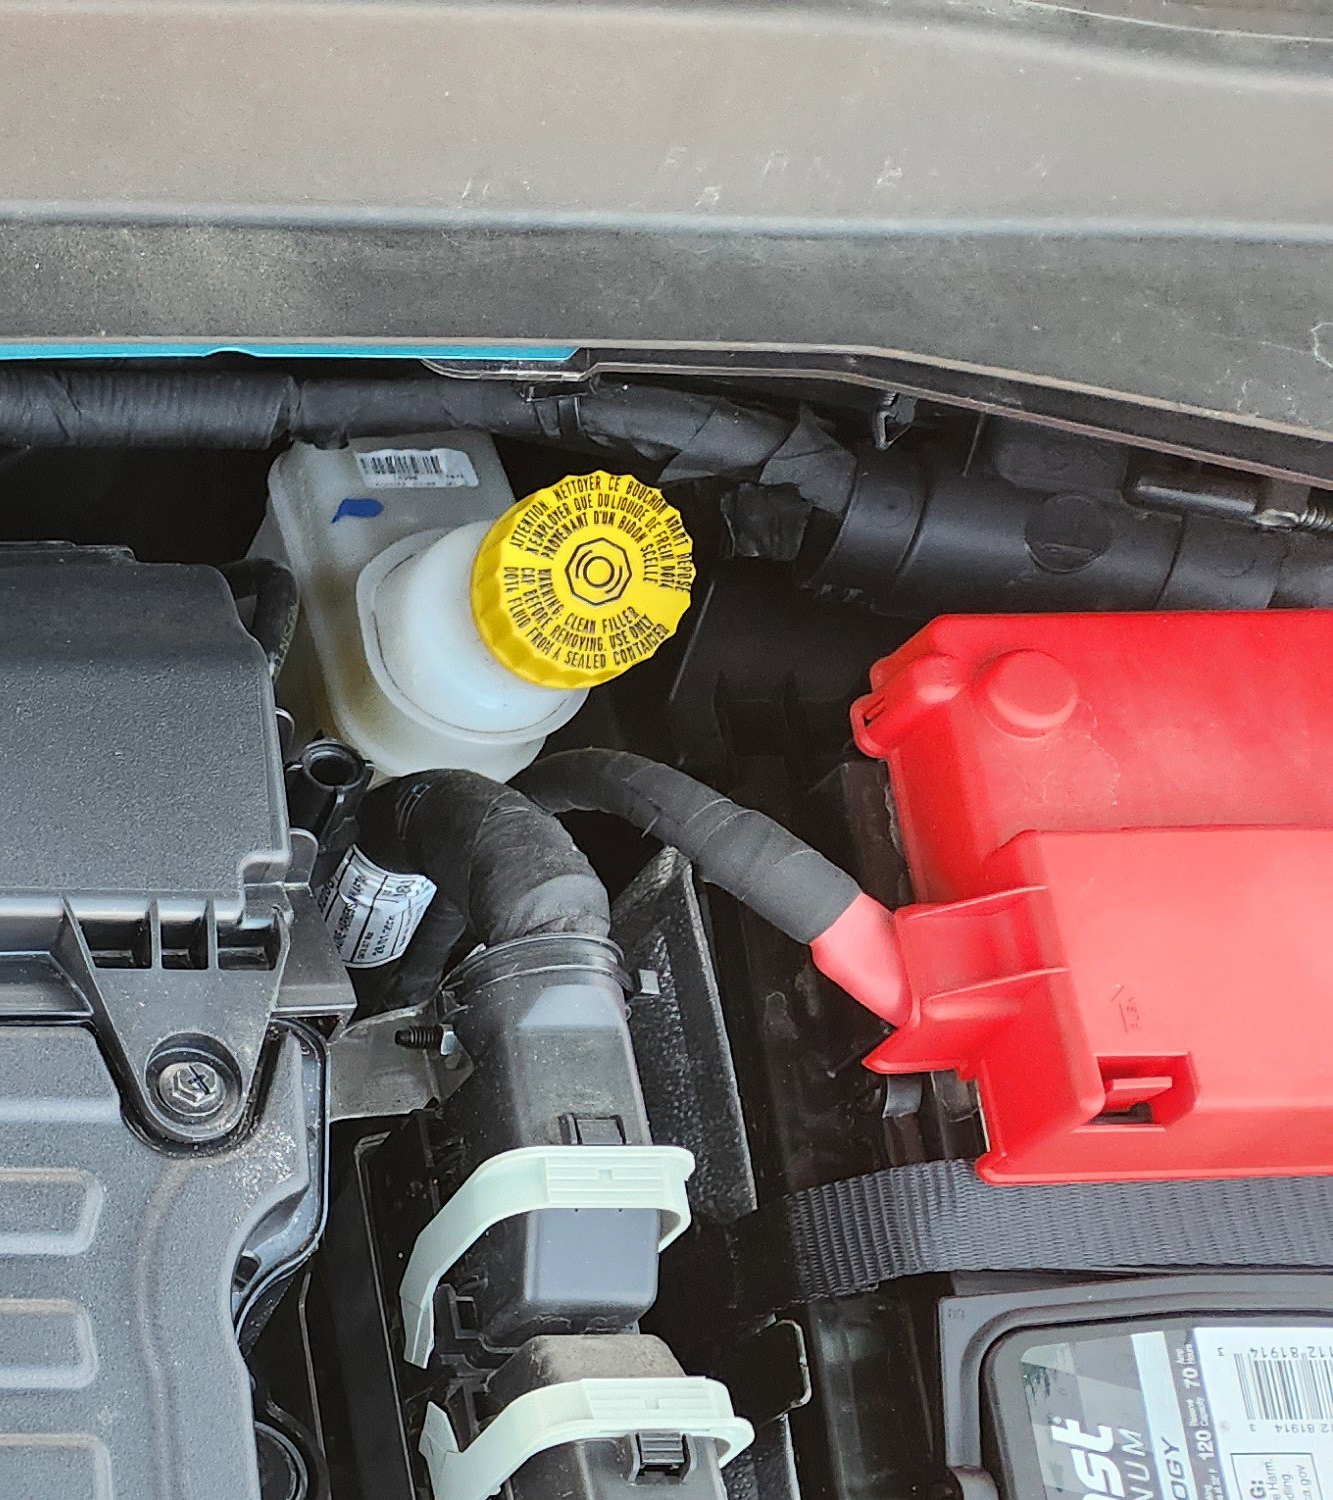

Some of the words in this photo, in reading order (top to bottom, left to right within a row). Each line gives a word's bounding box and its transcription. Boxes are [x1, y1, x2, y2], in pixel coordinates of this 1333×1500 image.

[553, 475, 601, 503] NETTOYER
[608, 475, 622, 493] CE
[626, 481, 669, 515] BOUCHON
[664, 514, 690, 547] AVANT
[540, 511, 589, 561] PROVENANT
[617, 515, 649, 545] BIDON
[573, 493, 594, 512] QUE
[644, 516, 663, 534] DE
[654, 530, 675, 561] FREIN
[520, 567, 536, 586] CAP
[522, 588, 554, 631] BEFORE
[563, 612, 597, 636] CLEAN
[602, 606, 640, 635] FILLER
[507, 596, 532, 629] FLUID
[525, 626, 555, 657] FROM
[552, 645, 563, 661] A
[563, 650, 607, 670] SEALED
[612, 623, 671, 667] CONTAINER
[629, 613, 654, 640] ONLY
[609, 629, 631, 650] USE
[1175, 1348, 1188, 1365] Amp
[1183, 1343, 1197, 1365] Hours
[1217, 1347, 1226, 1358] 3
[1249, 1347, 1298, 1359] 81914
[1182, 1367, 1202, 1390] 70
[1248, 1423, 1257, 1433] 3
[1274, 1422, 1315, 1434] 81914
[1195, 1429, 1215, 1461] 120
[1263, 1459, 1281, 1491] Harm.
